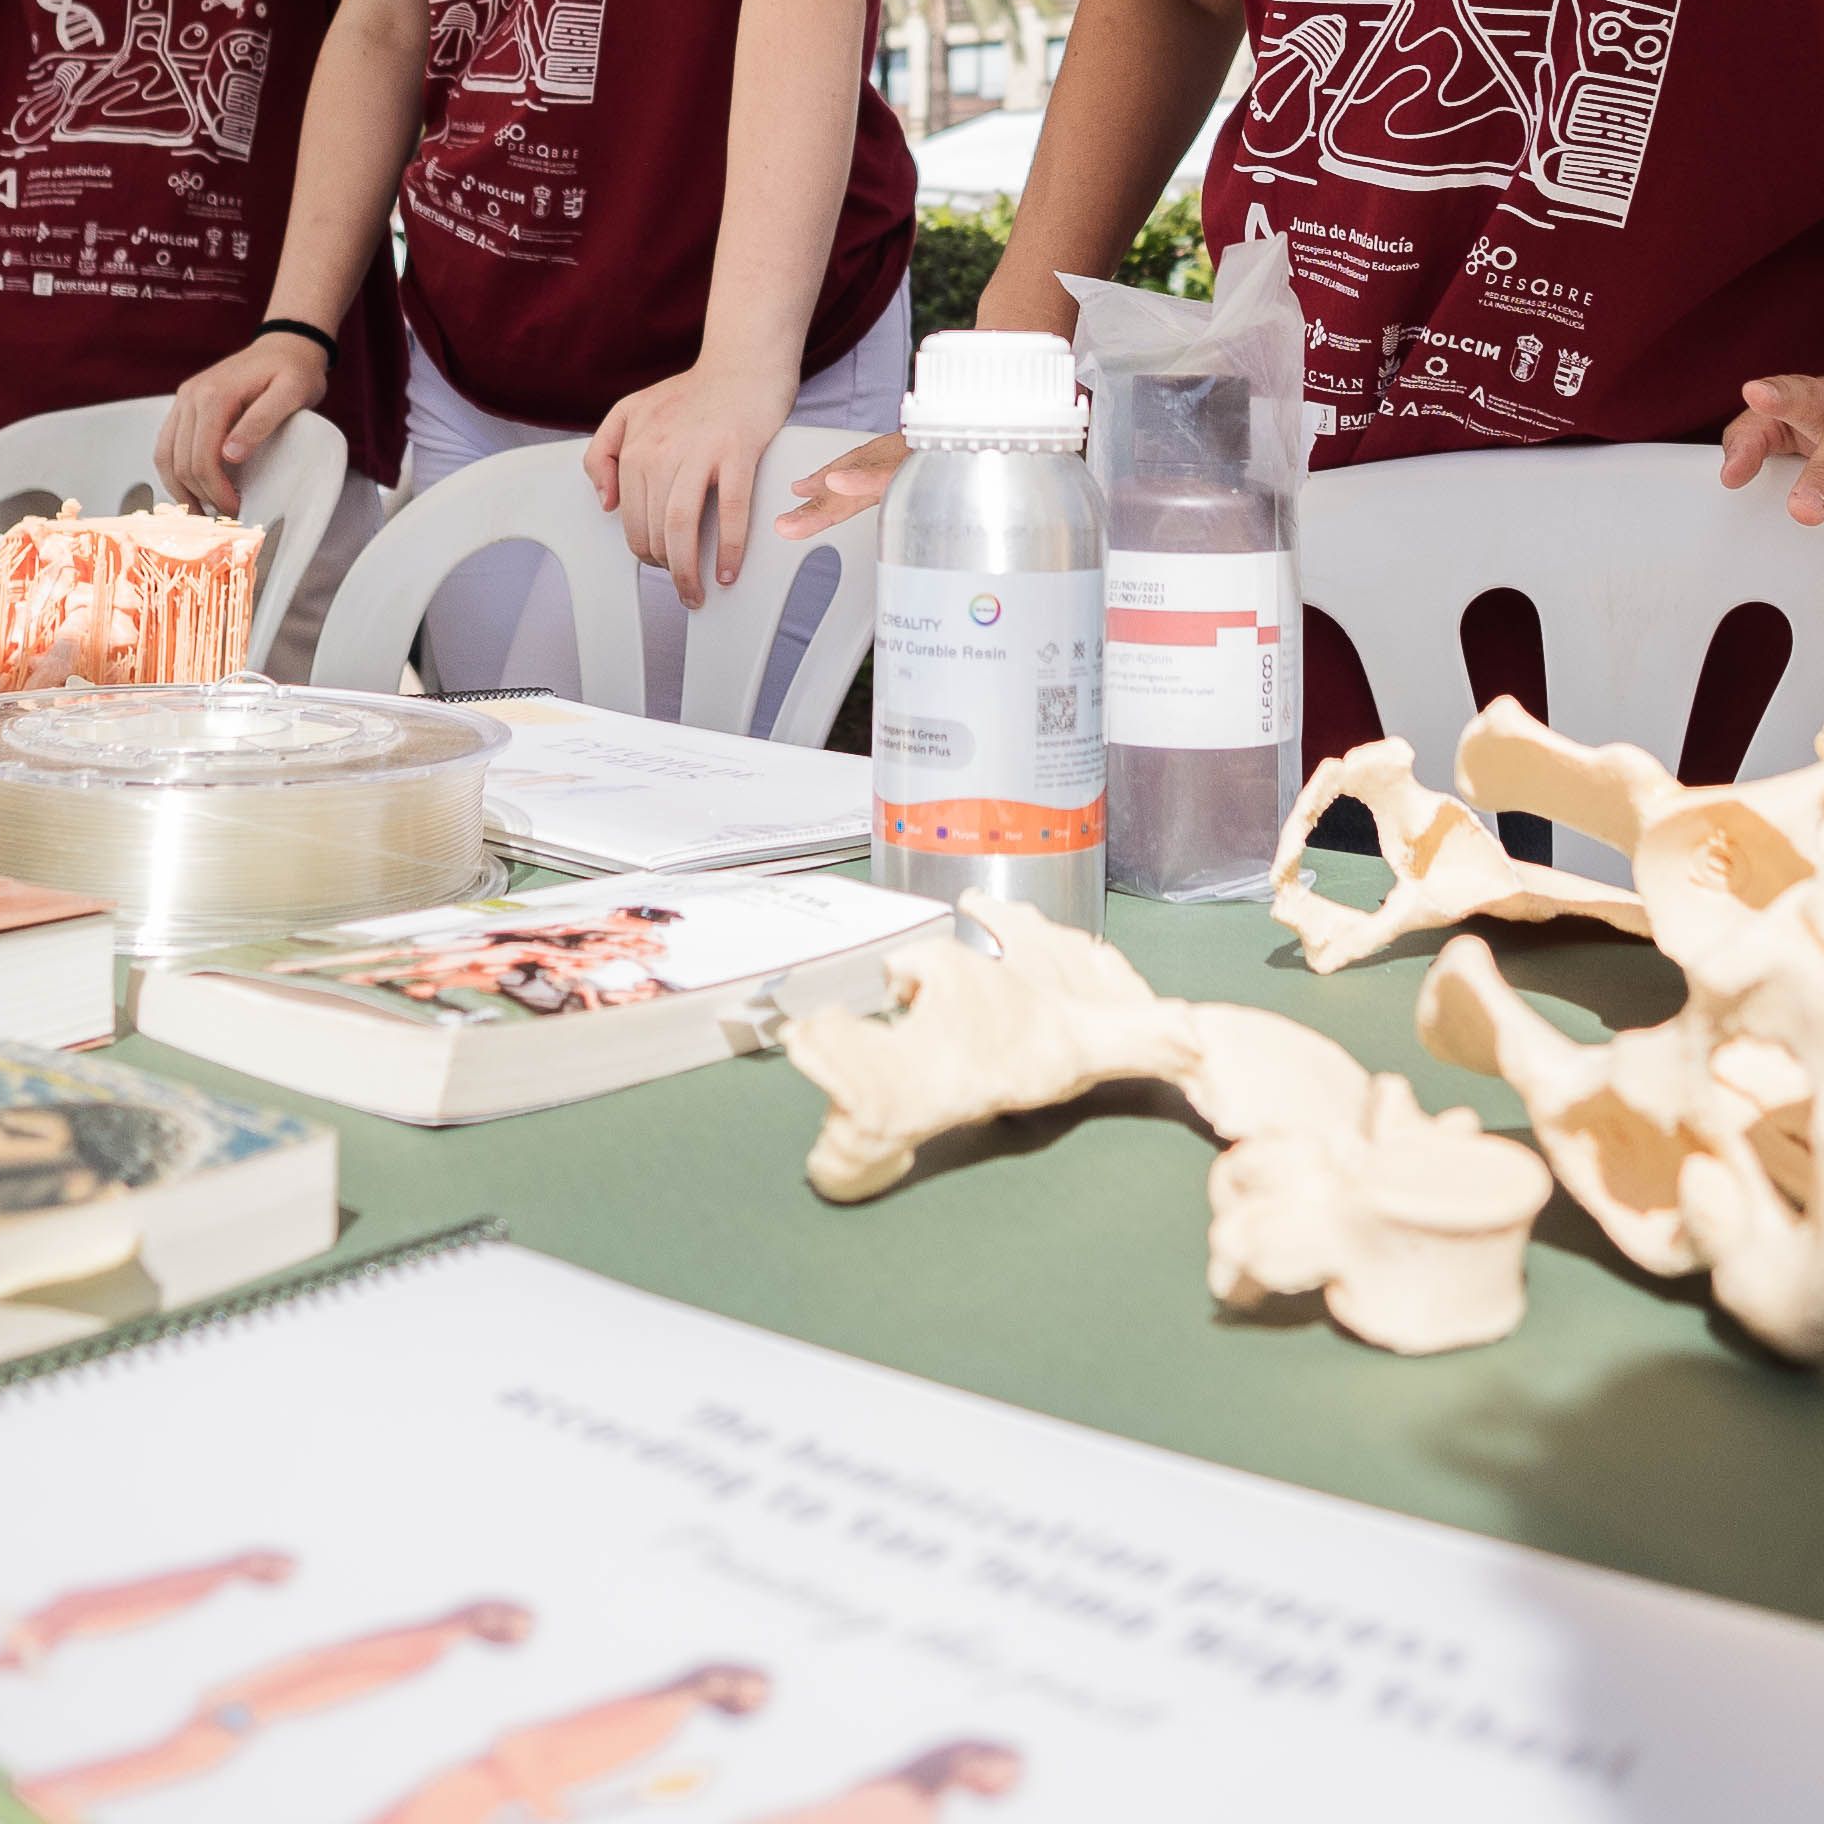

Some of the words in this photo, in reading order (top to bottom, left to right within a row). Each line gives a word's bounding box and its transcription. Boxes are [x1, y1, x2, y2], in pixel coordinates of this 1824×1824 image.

[508, 144, 579, 159] DESQBRE
[478, 182, 525, 205] HOLCIM
[149, 232, 199, 248] HOLCIM
[1289, 216, 1326, 237] Junta
[1329, 224, 1347, 240] de
[1348, 228, 1414, 253] Andalucía
[1291, 241, 1331, 256] Consejería
[1332, 249, 1342, 259] de
[1372, 261, 1420, 272] Educativo
[1300, 254, 1337, 270] Formación
[1485, 272, 1594, 306] DESQBRE
[1500, 294, 1509, 302] DE
[1511, 295, 1536, 307] FERIAS
[1537, 300, 1547, 308] DE
[1547, 302, 1557, 311] LA
[1558, 304, 1584, 319] CIENCIA
[1537, 308, 1547, 317] DE
[1420, 326, 1502, 361] HOLCIM
[882, 613, 942, 632] CREALITY
[889, 639, 903, 653] UV
[906, 641, 956, 659] Curable
[963, 645, 1006, 661] Resin
[1262, 654, 1273, 734] ELEGOO
[918, 729, 948, 742] Green
[928, 745, 952, 758] Plus
